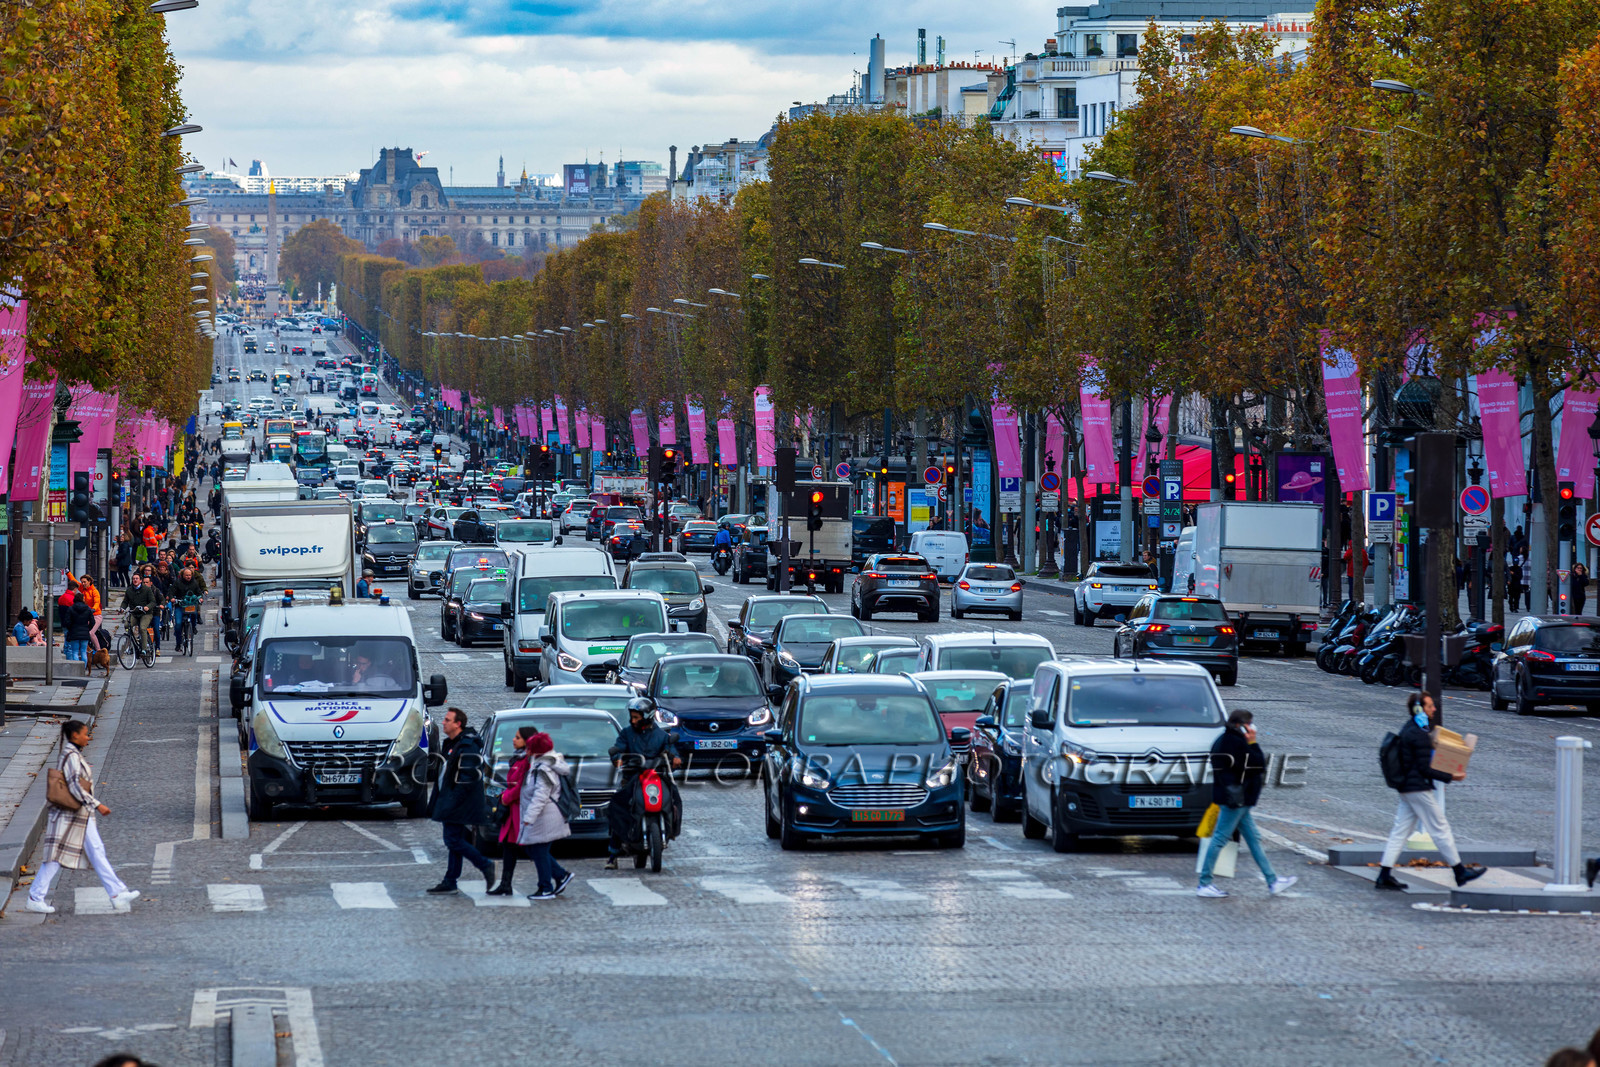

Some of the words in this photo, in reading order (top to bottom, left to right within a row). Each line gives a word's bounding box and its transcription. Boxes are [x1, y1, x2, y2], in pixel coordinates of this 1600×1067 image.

[1326, 361, 1355, 370] POTO
[1005, 477, 1014, 489] P
[1166, 483, 1179, 500] P
[1376, 498, 1390, 516] P
[259, 544, 324, 556] swipop.fr
[855, 812, 868, 820] 115
[885, 811, 903, 820] 1773
